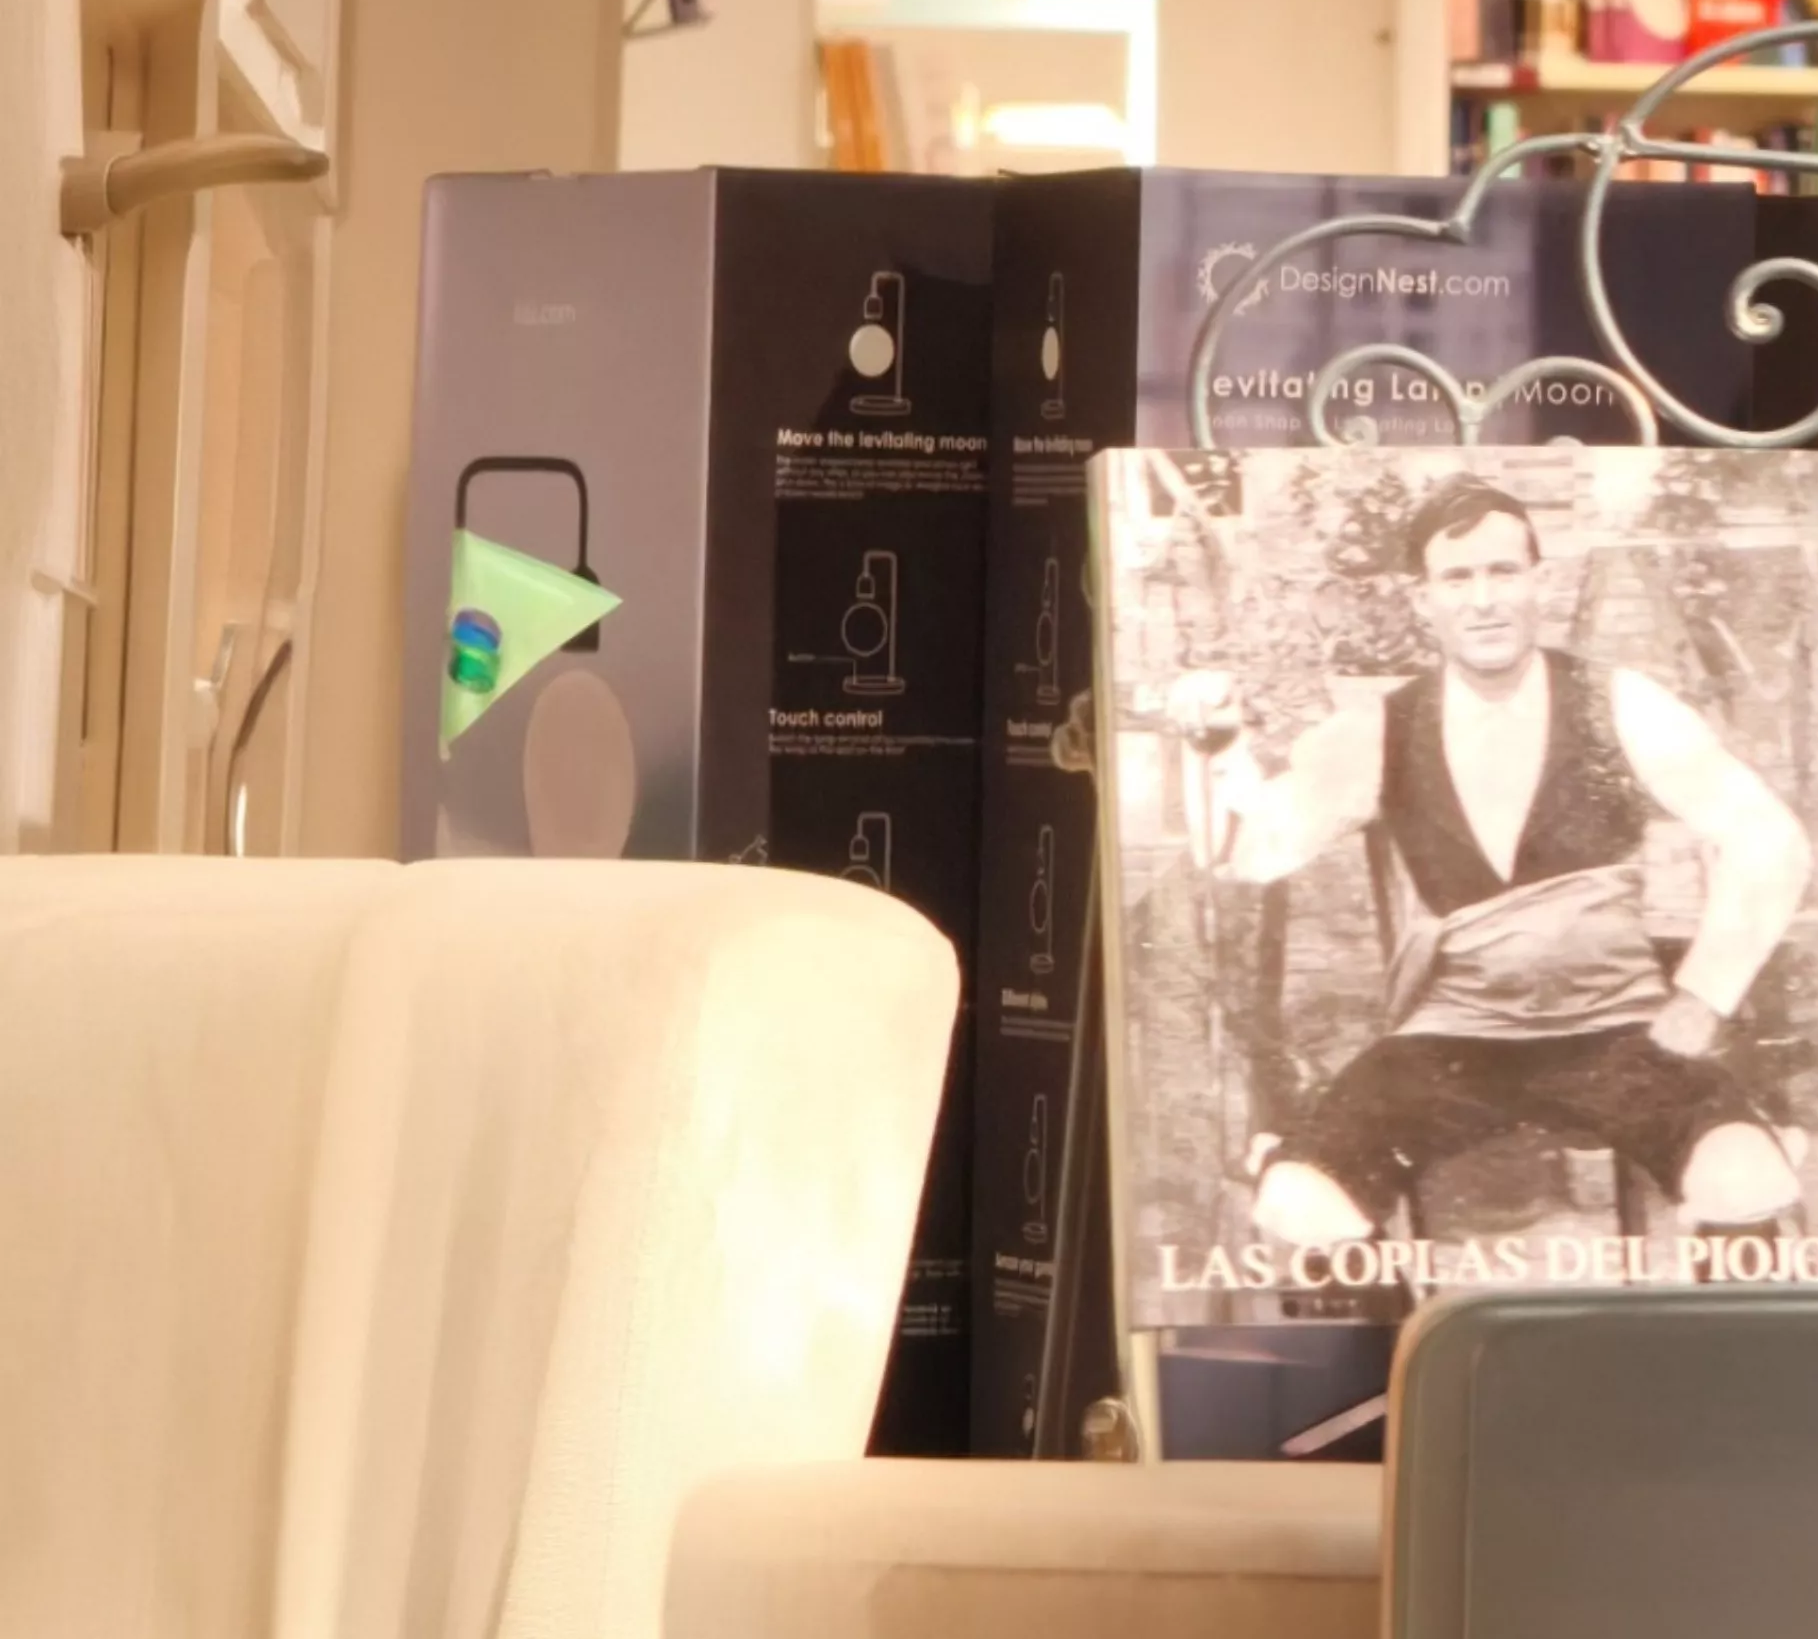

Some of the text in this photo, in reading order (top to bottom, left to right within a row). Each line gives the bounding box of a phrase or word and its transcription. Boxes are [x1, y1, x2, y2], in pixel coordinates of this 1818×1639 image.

[1279, 264, 1511, 299] DesignNest.com
[1205, 368, 1376, 407] evitang
[1390, 371, 1487, 404] Lap
[777, 427, 824, 447] Move
[939, 435, 987, 452] moon
[768, 707, 883, 727] Touch control
[1157, 1242, 1277, 1292] LAS
[1289, 1235, 1530, 1290] COPLAS
[1546, 1234, 1660, 1284] DEL
